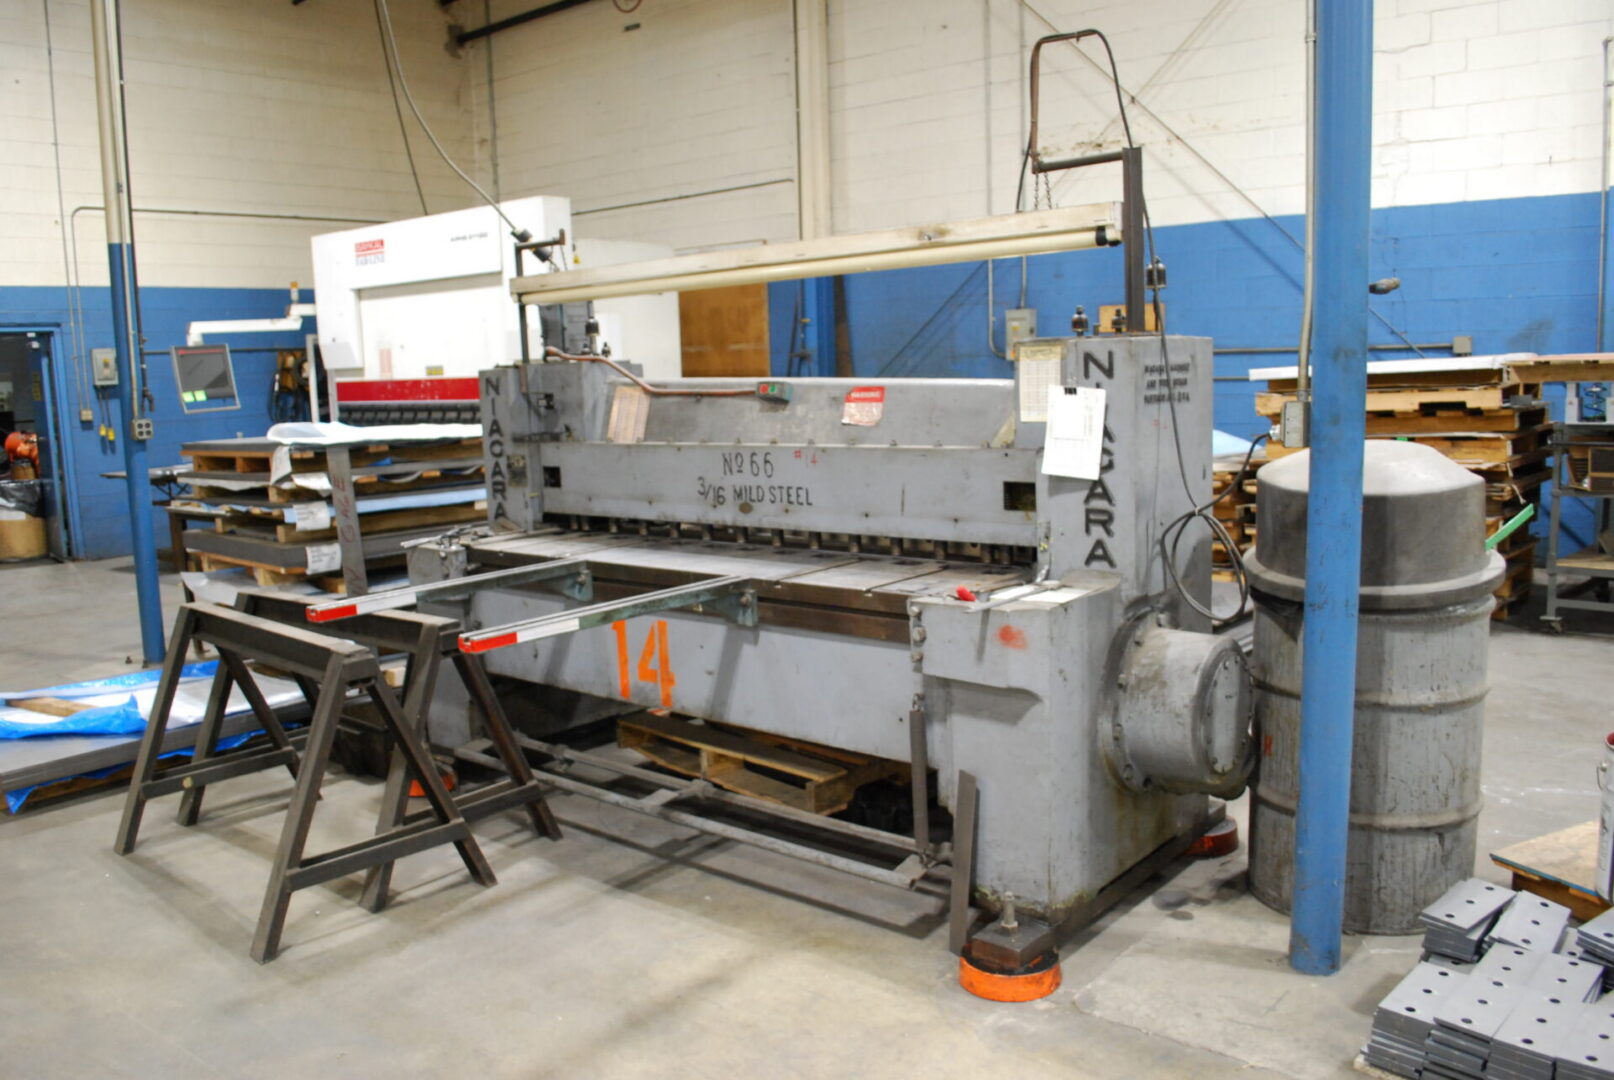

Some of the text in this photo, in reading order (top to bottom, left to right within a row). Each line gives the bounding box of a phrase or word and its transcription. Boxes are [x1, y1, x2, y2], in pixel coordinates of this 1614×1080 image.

[750, 451, 774, 478] 66
[1083, 350, 1116, 569] NARA
[697, 476, 813, 506] 3/16 MILD STEEL
[611, 619, 675, 708] 14
